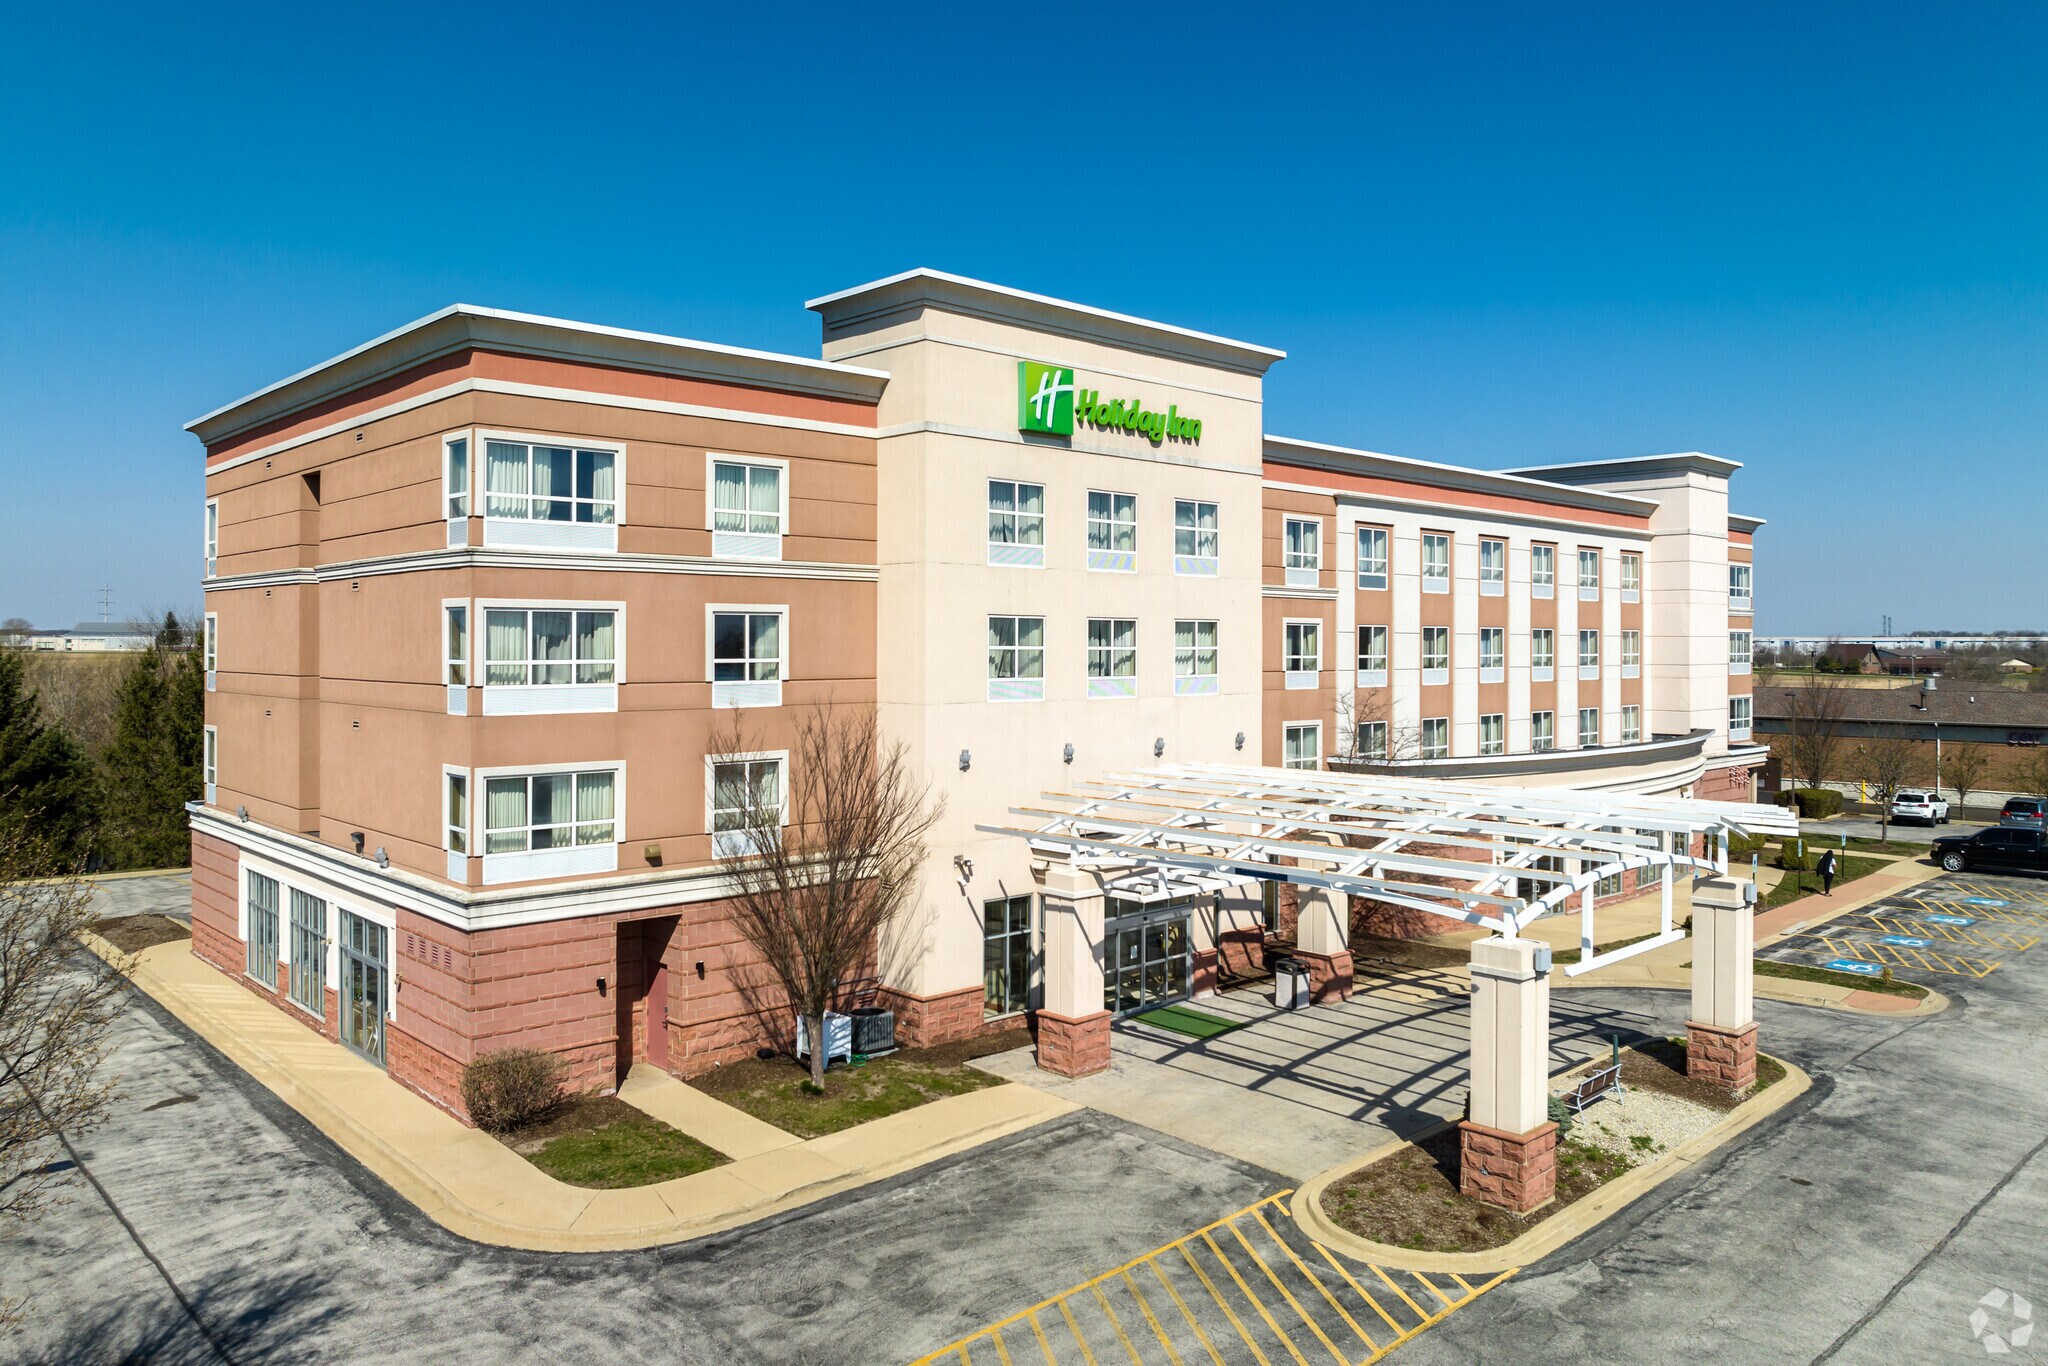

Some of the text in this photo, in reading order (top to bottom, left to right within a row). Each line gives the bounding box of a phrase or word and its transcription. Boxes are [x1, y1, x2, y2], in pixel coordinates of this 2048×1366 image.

[1030, 370, 1073, 428] H
[1075, 389, 1202, 441] Holiday Inn
